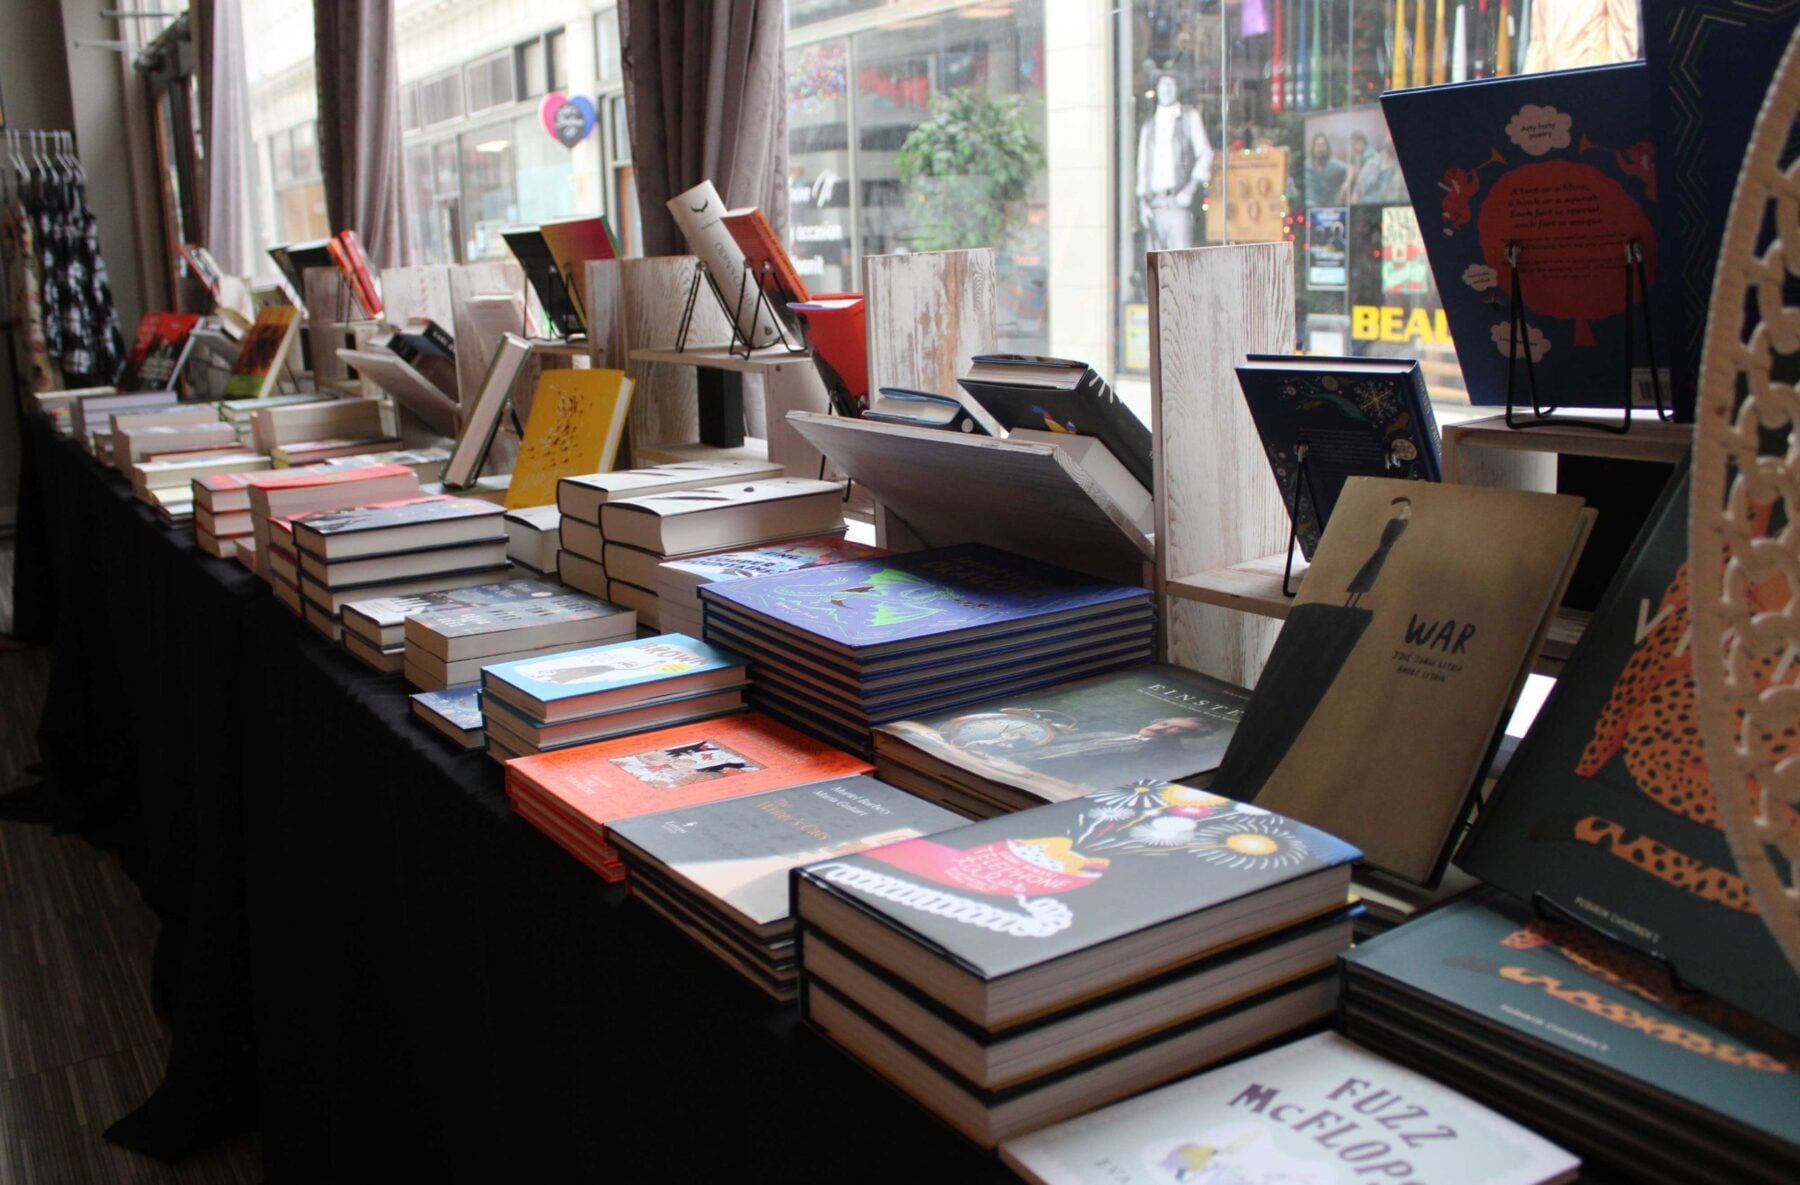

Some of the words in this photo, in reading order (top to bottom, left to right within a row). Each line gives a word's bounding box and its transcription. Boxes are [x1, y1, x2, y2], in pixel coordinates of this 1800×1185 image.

[634, 643, 713, 665] BROWN
[1405, 613, 1476, 654] WAR
[973, 846, 1074, 889] TELEPHONE
[1227, 1082, 1430, 1185] McFLOP
[1324, 1077, 1459, 1149] FUZZ
